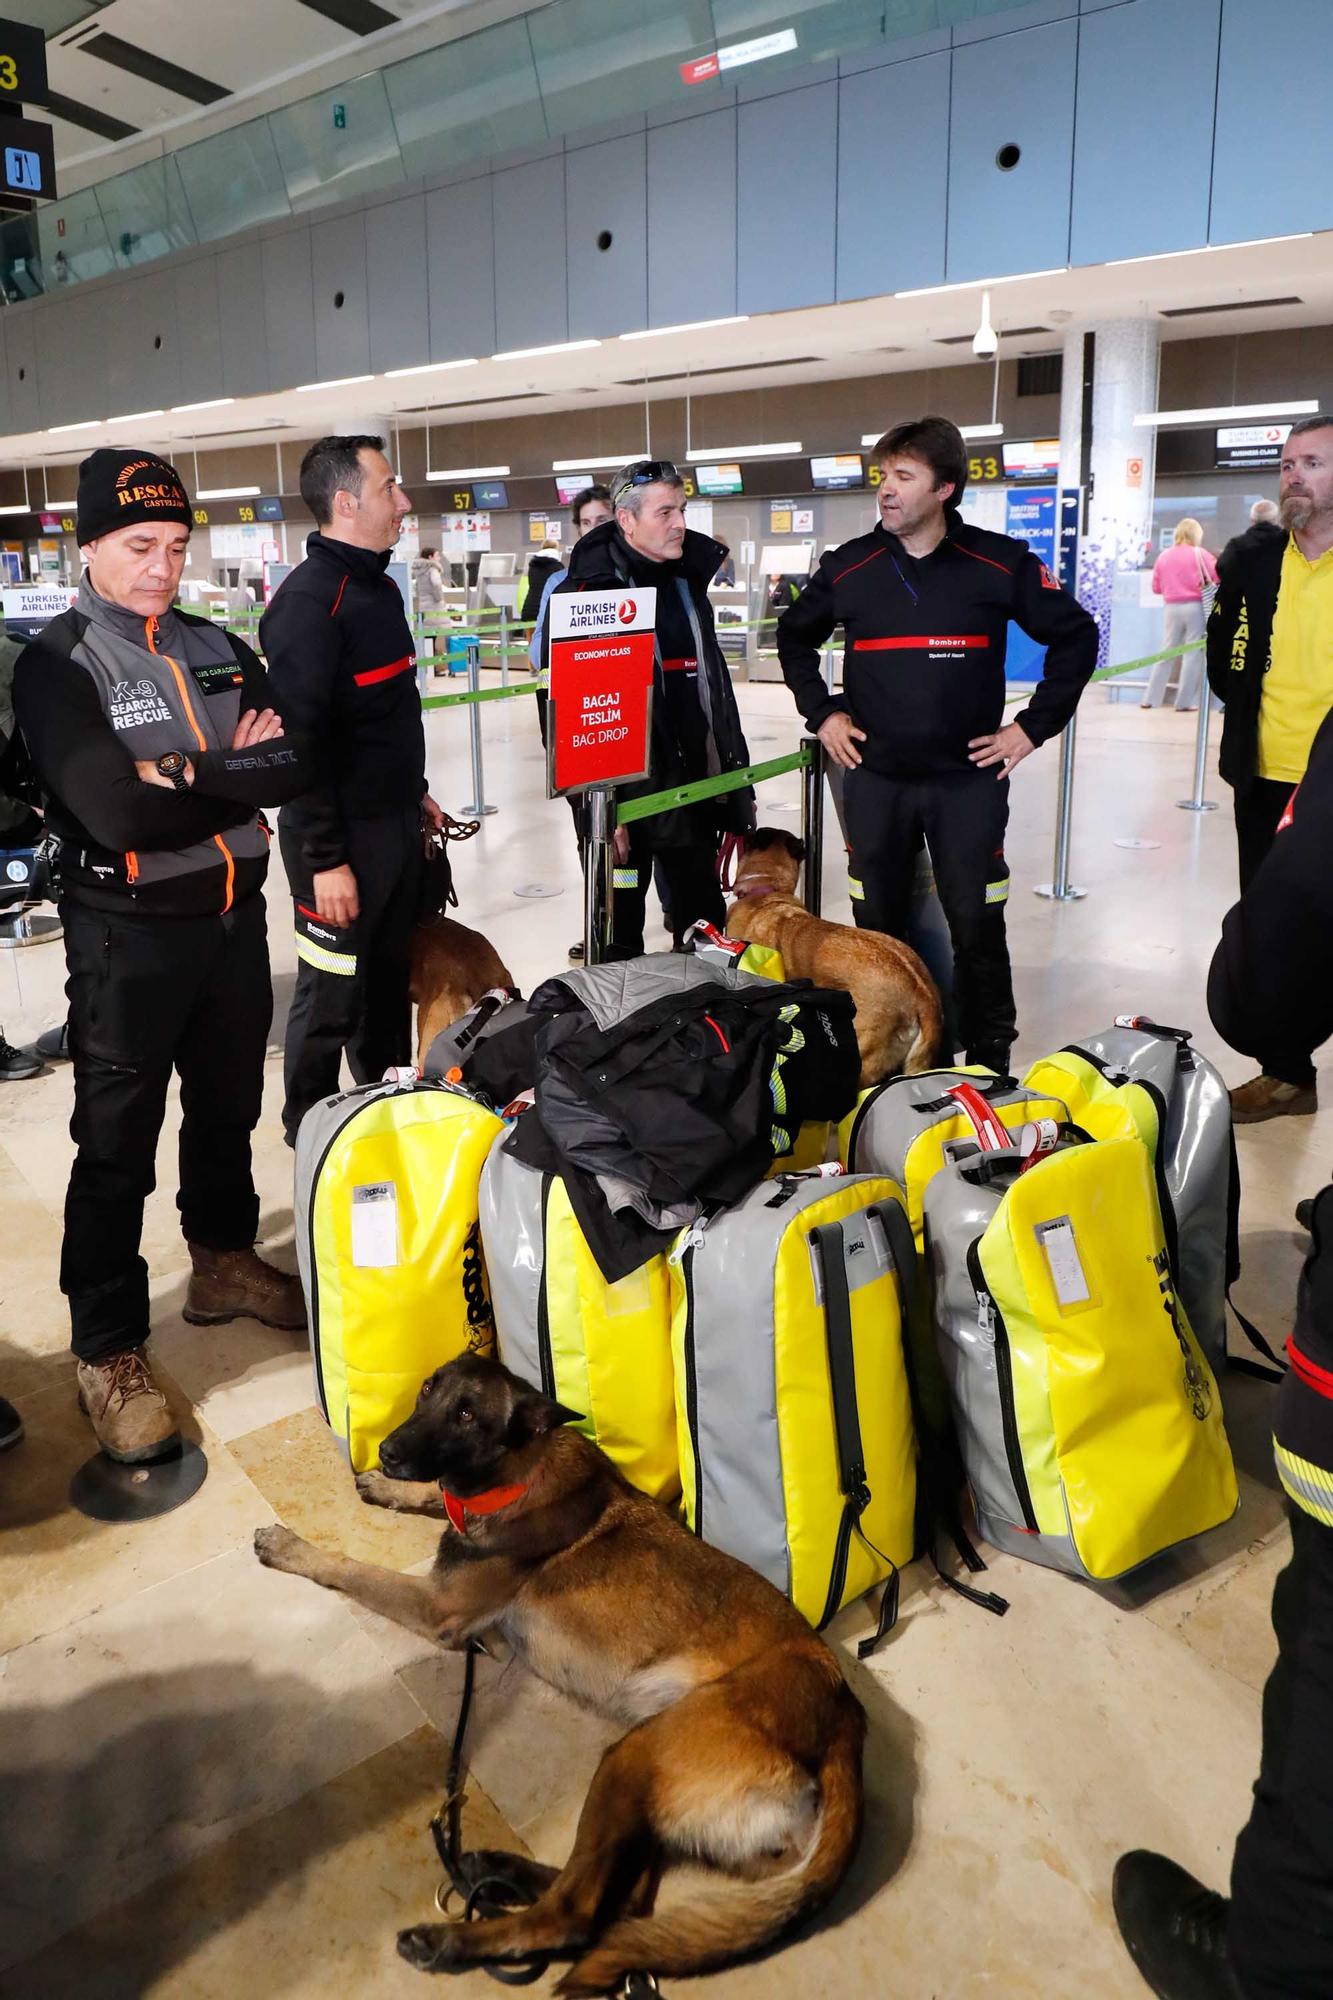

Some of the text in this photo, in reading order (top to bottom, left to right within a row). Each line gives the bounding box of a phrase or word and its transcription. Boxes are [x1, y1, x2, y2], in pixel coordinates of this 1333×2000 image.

[869, 465, 880, 485] 5
[969, 457, 997, 480] 53
[117, 484, 181, 506] RESCA
[454, 493, 470, 509] 57
[194, 510, 208, 524] 60
[239, 507, 253, 521] 59
[62, 518, 75, 531] 62
[1008, 528, 1053, 537] CHECK-IN
[20, 594, 67, 603] TURKISH
[21, 602, 68, 612] AIRLINES
[570, 602, 617, 616] TURKISH
[569, 614, 616, 628] AIRLINES
[929, 638, 966, 646] Bombers
[574, 647, 631, 661] ECONOMY CLASS
[1230, 657, 1245, 671] 13
[111, 679, 157, 703] K-9
[110, 697, 166, 716] SEARCH &
[582, 692, 620, 710] BAGAJ
[112, 707, 173, 730] RESCUE
[580, 708, 621, 726] TESLİM
[572, 726, 629, 748] BAG DROP
[307, 921, 337, 941] Bombers
